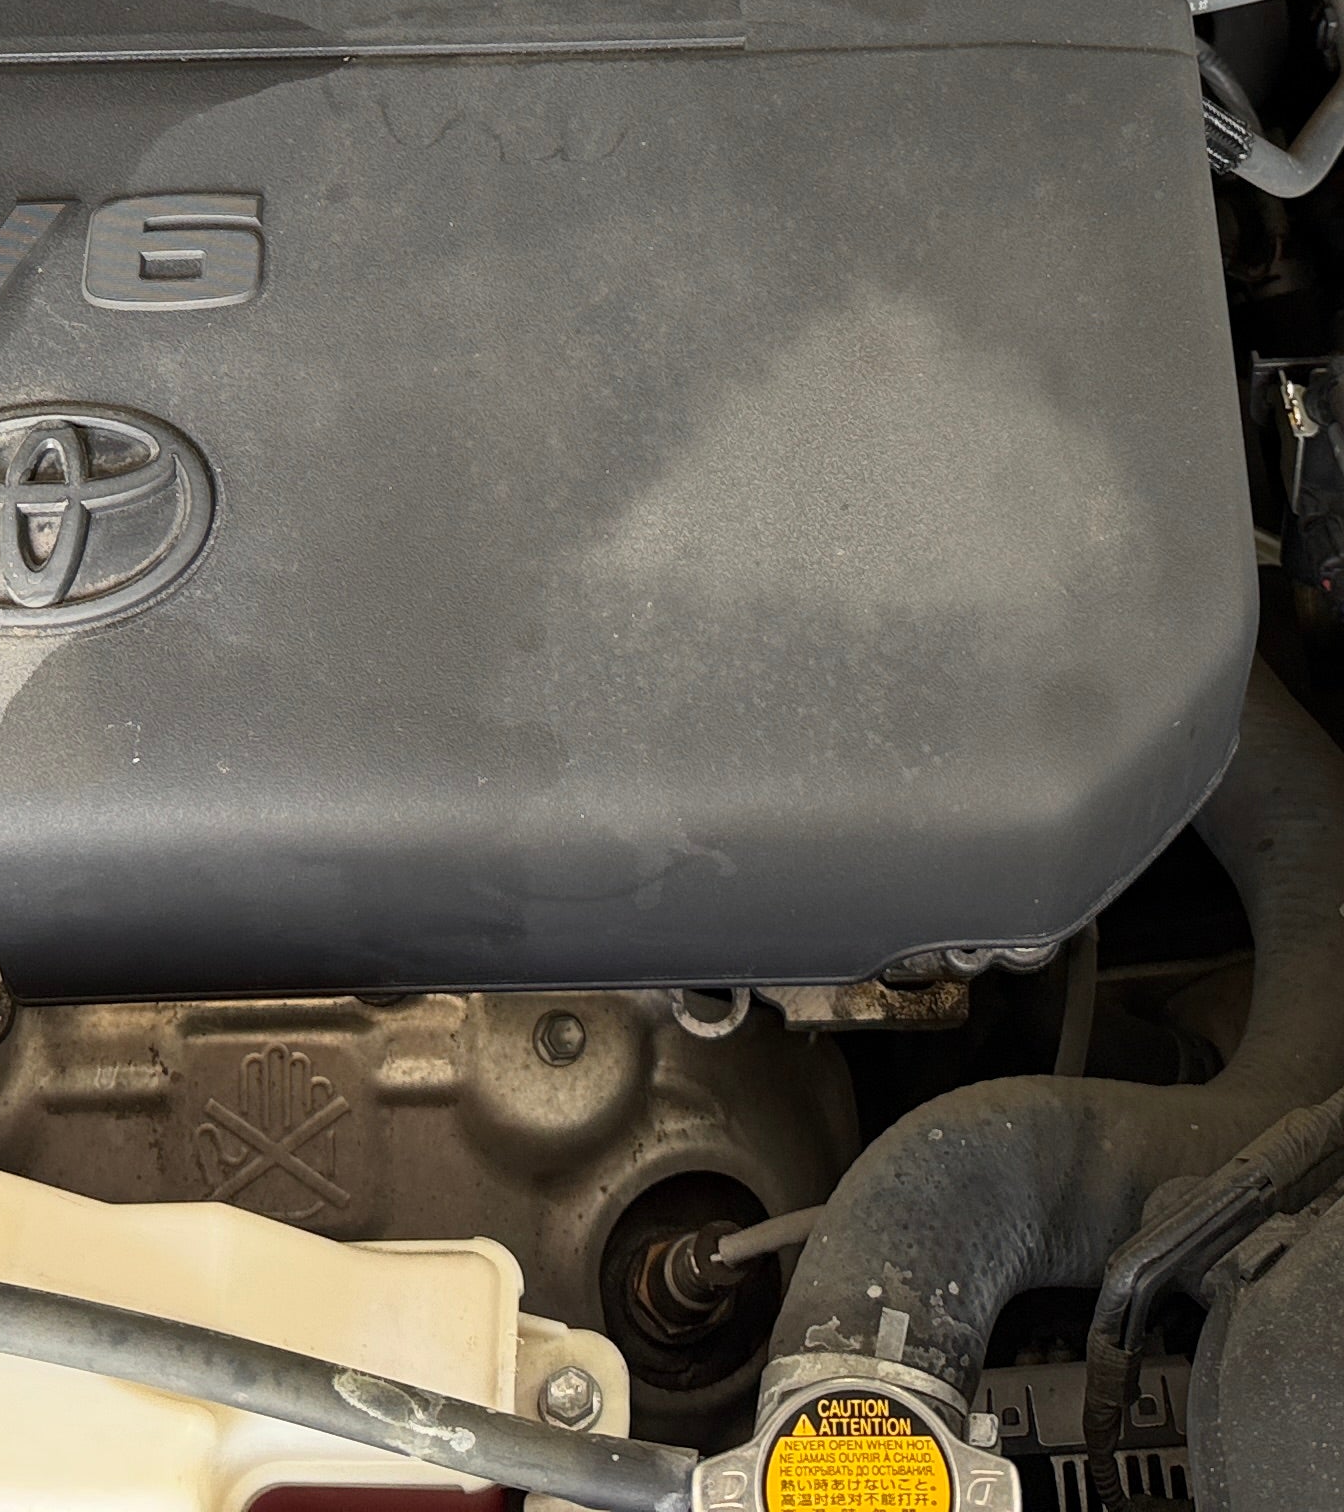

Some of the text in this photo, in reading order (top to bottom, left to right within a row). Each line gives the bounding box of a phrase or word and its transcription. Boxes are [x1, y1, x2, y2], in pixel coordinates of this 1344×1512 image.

[817, 1399, 890, 1418] CAUTION
[818, 1417, 912, 1436] ATTENTION
[784, 1439, 826, 1451] NEVER
[828, 1439, 863, 1451] OPEN
[865, 1439, 903, 1451] WHEN
[779, 1453, 794, 1464] NE
[796, 1453, 836, 1464] JAMAIS
[838, 1452, 881, 1463] OUVRIR
[779, 1465, 793, 1477] НЕ
[794, 1465, 854, 1477] ОТКРЫВАТЬ
[856, 1465, 869, 1477] ДО
[780, 1479, 937, 1492] 熱い時あけないこと。
[780, 1493, 938, 1506] 高温时绝对不能打开。
